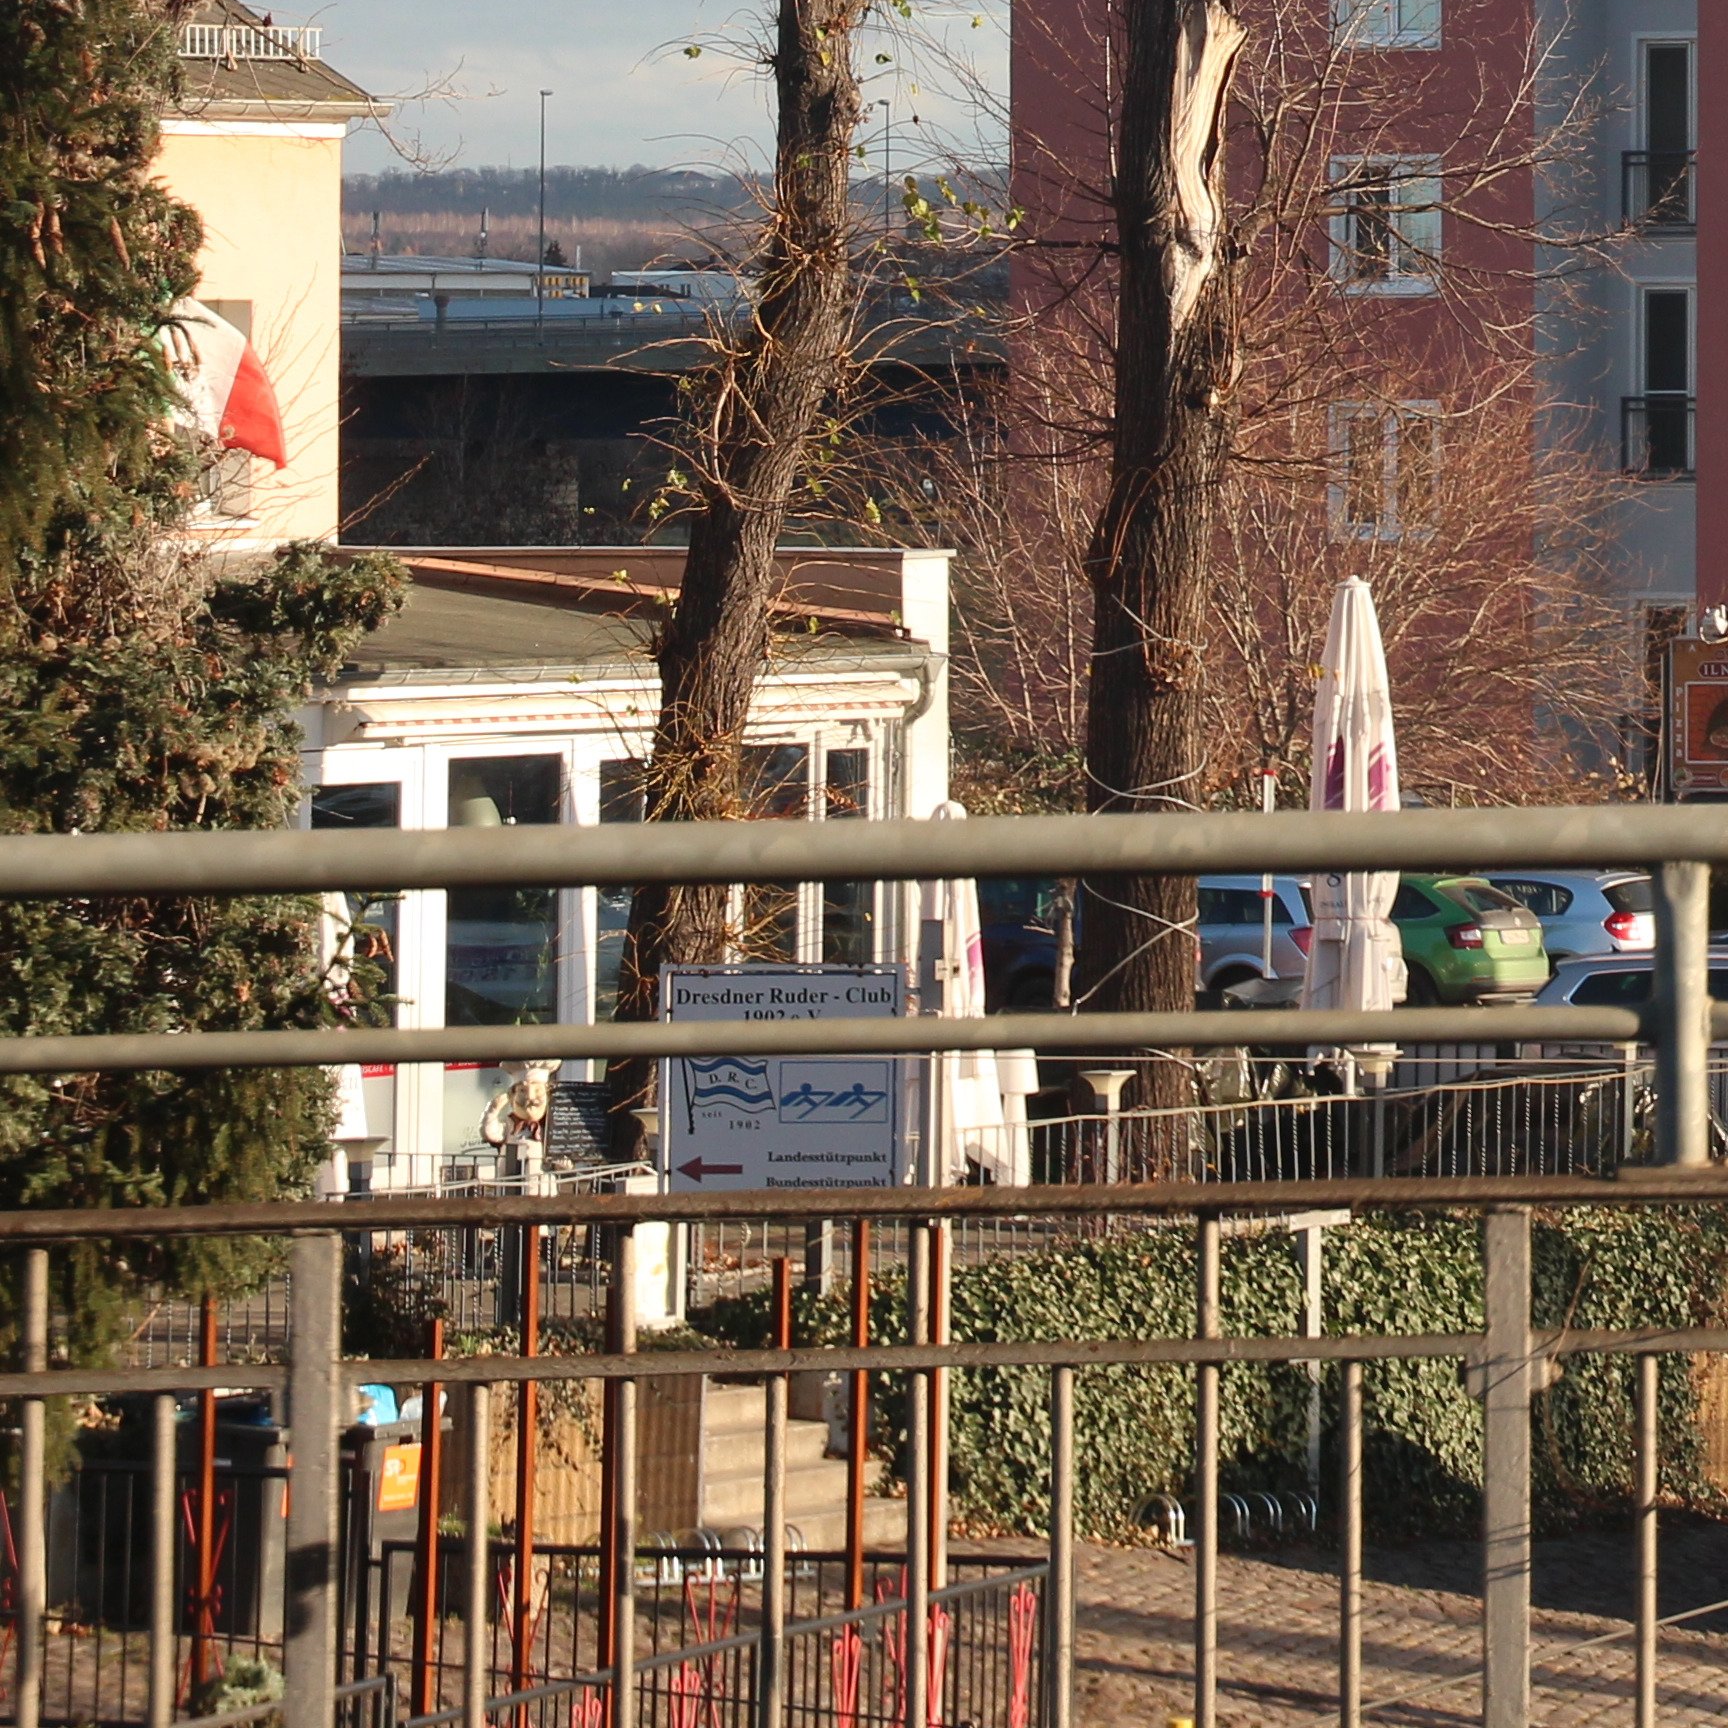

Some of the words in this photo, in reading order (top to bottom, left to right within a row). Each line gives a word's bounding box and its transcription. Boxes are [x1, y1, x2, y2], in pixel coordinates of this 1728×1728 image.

[677, 987, 765, 1006] Dresdner
[769, 988, 829, 1005] Ruder
[845, 987, 892, 1004] Club
[708, 1073, 722, 1084] D.
[727, 1071, 740, 1083] R.
[744, 1078, 758, 1090] C.
[701, 1110, 723, 1119] seit
[729, 1119, 761, 1130] 1902
[767, 1150, 887, 1165] Landesstützpunkt
[766, 1176, 887, 1188] Bundesstützpunkt
